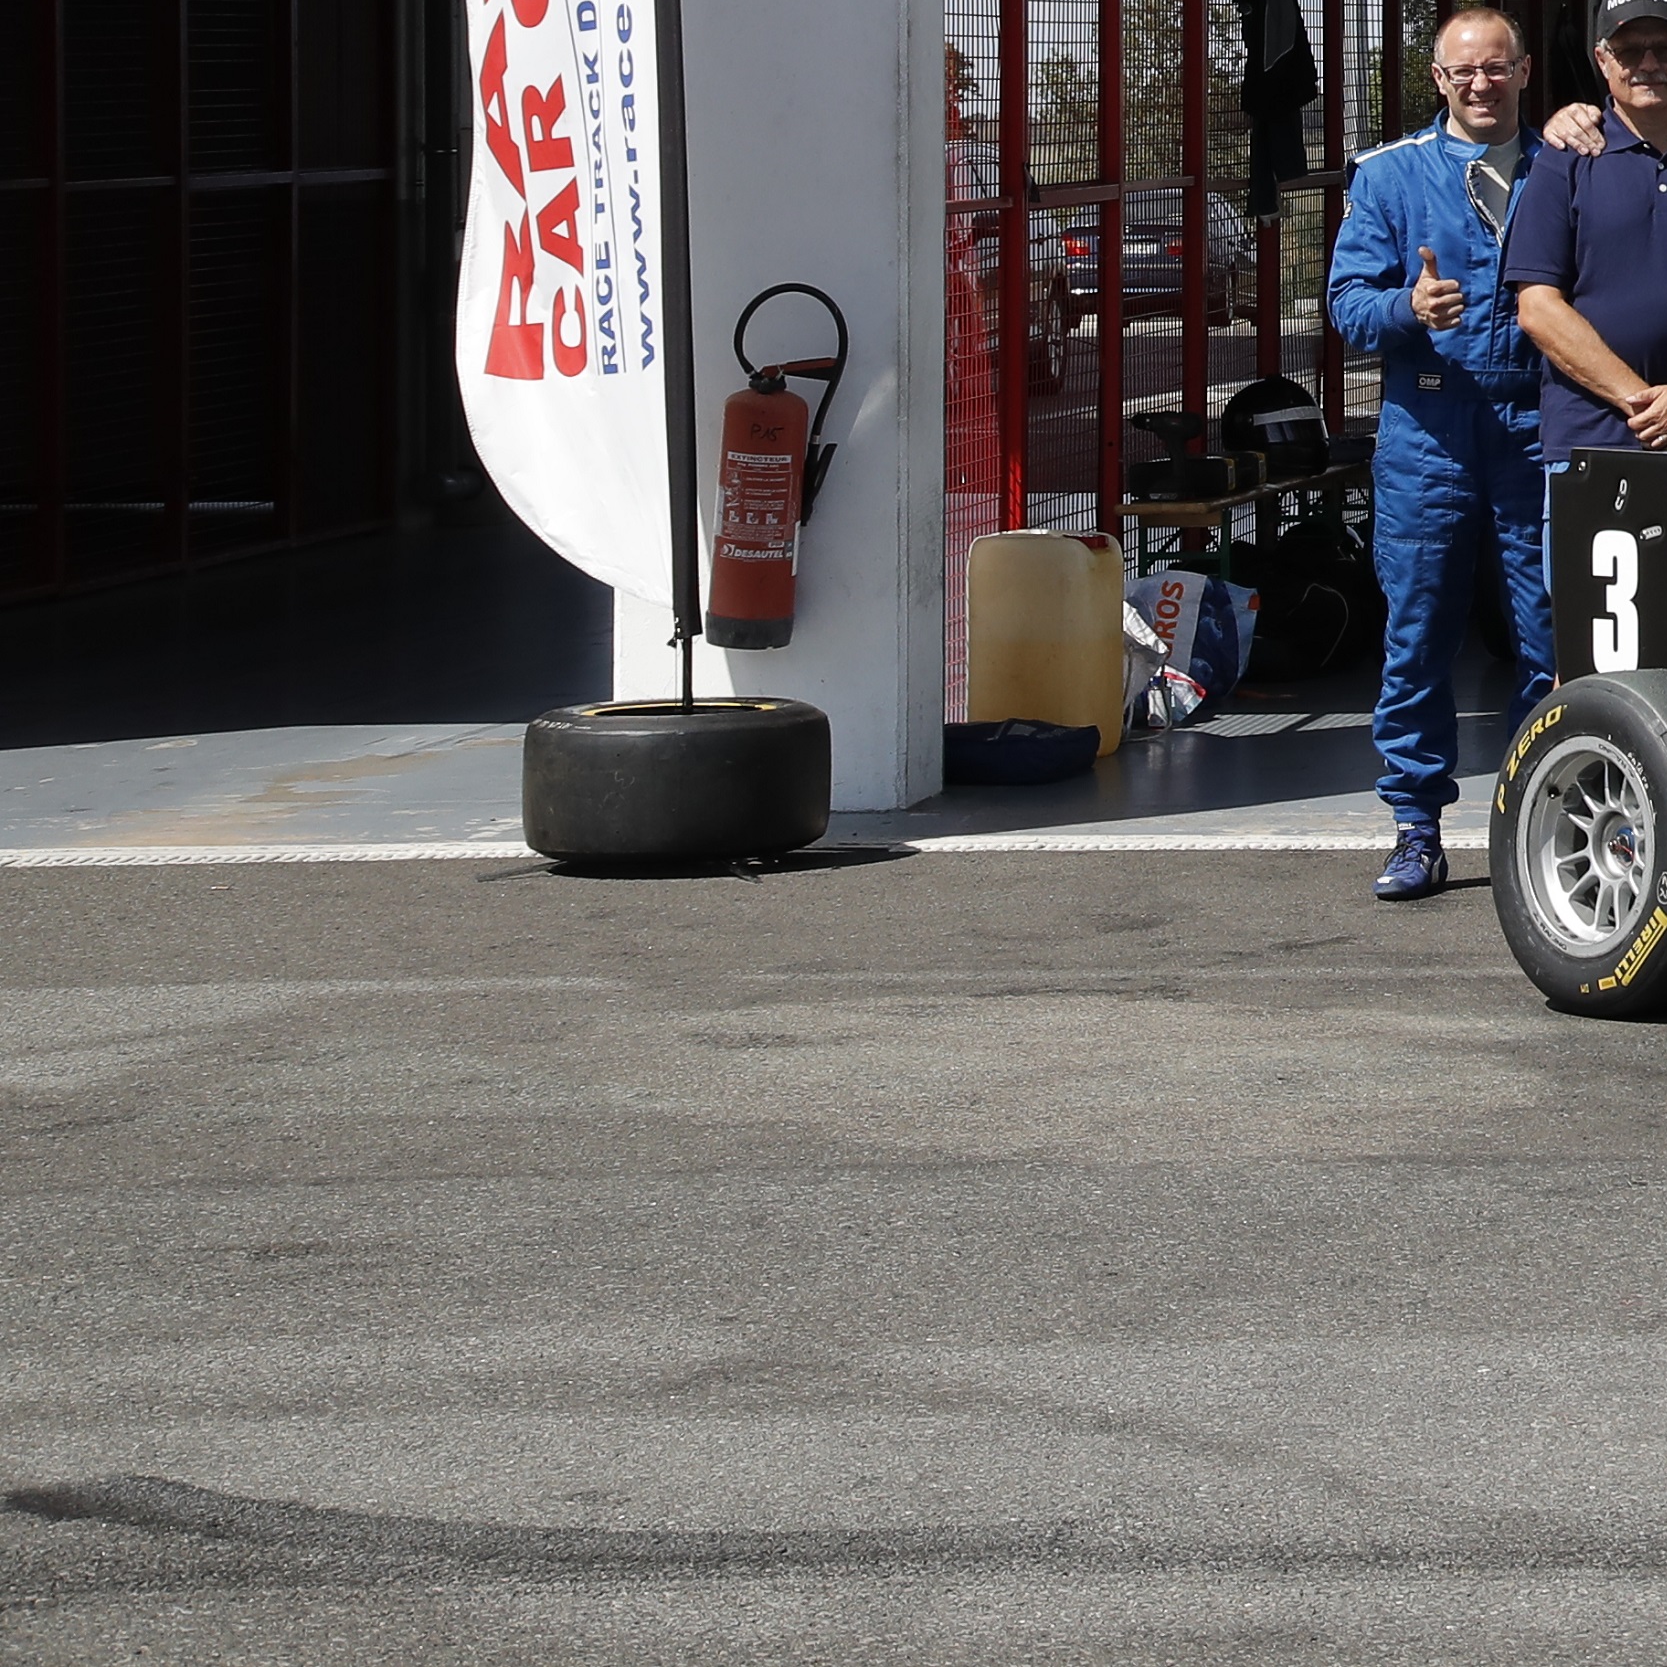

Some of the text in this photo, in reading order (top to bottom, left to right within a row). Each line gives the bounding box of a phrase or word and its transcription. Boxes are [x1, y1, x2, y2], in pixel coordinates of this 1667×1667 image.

[581, 51, 606, 224] TRACK
[521, 72, 588, 377] CAR
[594, 241, 618, 375] RACE
[1418, 377, 1441, 387] OMP
[730, 452, 789, 463] EXTINCTEUR
[733, 547, 784, 559] DESAUTEL
[1592, 529, 1639, 674] 3
[1496, 704, 1564, 814] P ZERO
